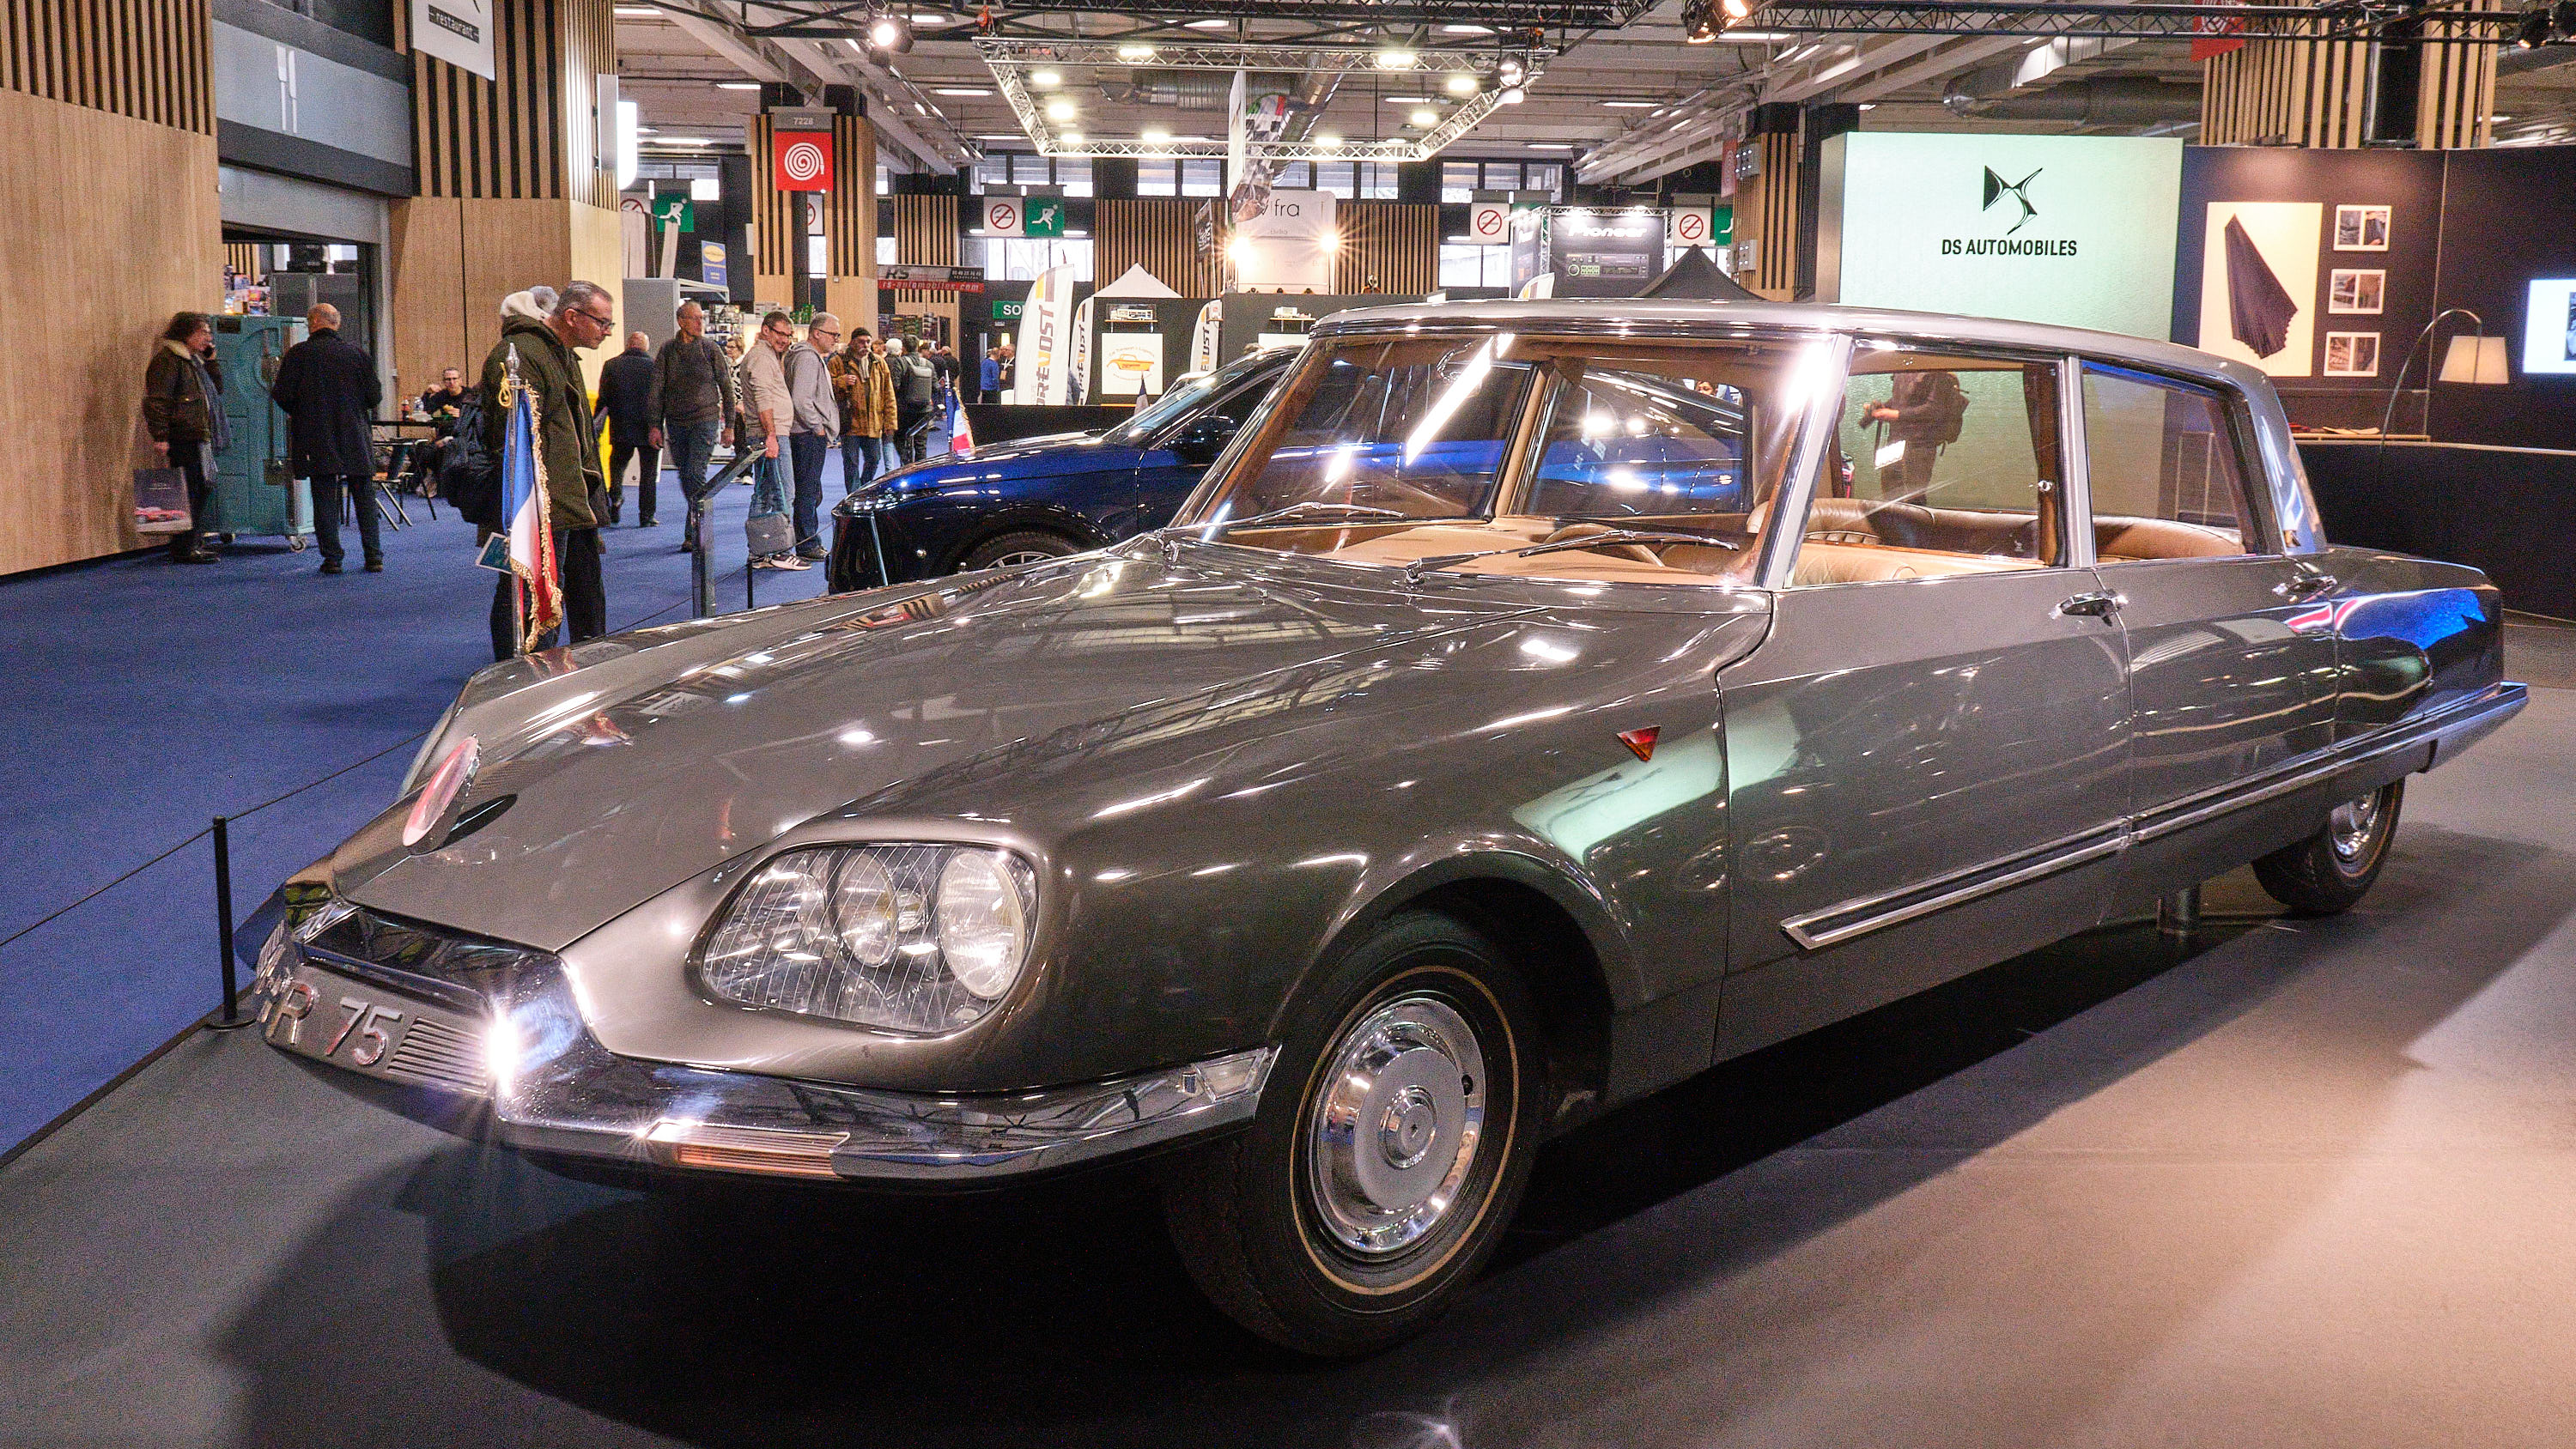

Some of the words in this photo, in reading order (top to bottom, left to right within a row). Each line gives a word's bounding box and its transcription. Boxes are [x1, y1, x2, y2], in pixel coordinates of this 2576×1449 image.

[1568, 223, 1648, 238] Pioneer
[1941, 239, 1962, 255] DS
[1965, 239, 2078, 256] AUTOMOBILES
[1003, 305, 1023, 316] SO
[325, 997, 403, 1066] 75
